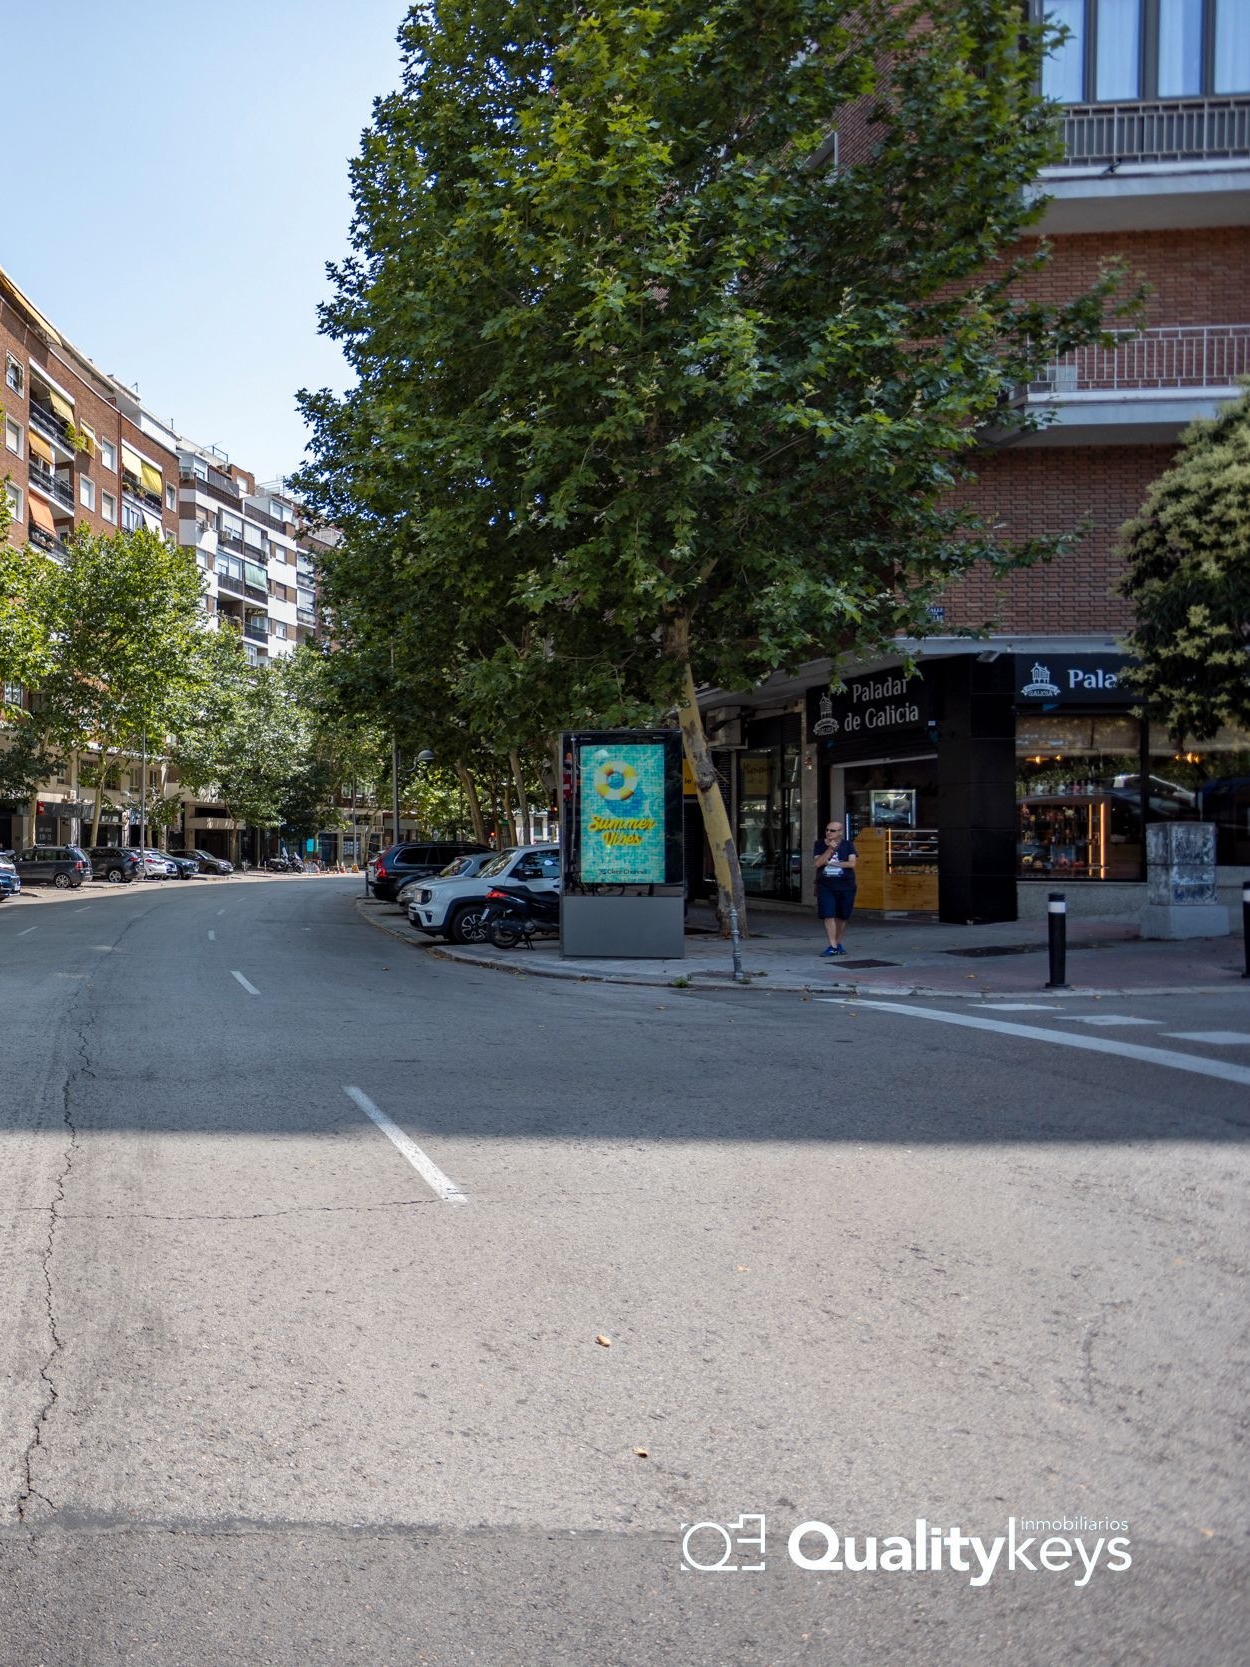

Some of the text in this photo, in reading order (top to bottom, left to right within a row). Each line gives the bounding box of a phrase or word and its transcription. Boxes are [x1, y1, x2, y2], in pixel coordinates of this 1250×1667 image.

[852, 677, 909, 703] Paladar
[1067, 668, 1118, 689] Pala
[844, 713, 861, 732] de
[865, 702, 919, 729] Galicia
[588, 816, 656, 832] Summer
